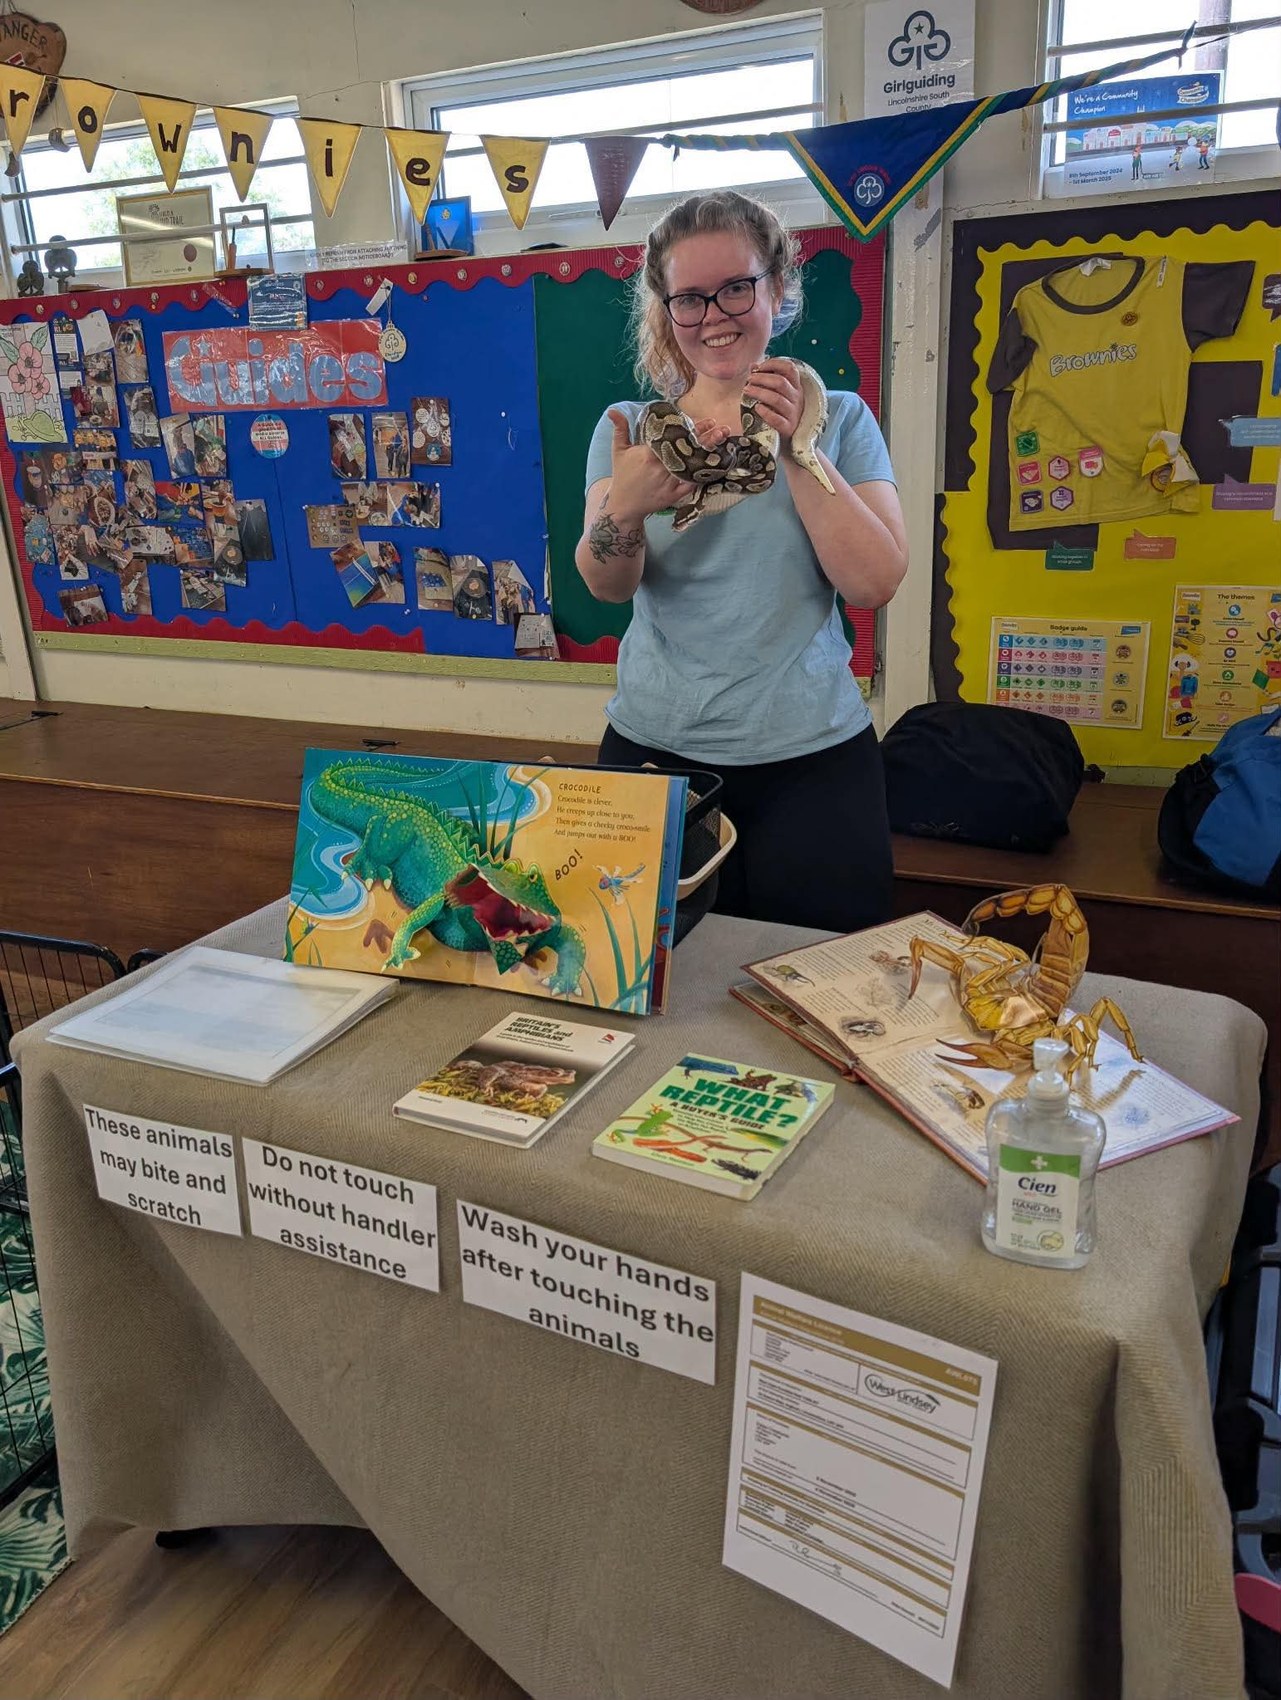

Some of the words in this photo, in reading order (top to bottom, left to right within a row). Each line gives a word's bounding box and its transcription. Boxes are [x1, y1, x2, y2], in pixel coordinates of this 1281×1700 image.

[0, 20, 48, 49] ANGER
[883, 74, 956, 94] Girlguiding
[888, 95, 928, 106] Lincolnshire
[929, 91, 950, 100] South
[1101, 89, 1139, 101] Community
[1074, 106, 1106, 115] Champion
[168, 335, 383, 407] Guides
[1049, 342, 1137, 377] Brownies
[558, 794, 586, 804] Crocodile
[559, 783, 602, 794] CROCODILE
[556, 817, 570, 825] Then
[571, 819, 586, 827] gives
[566, 808, 585, 816] creeps
[567, 830, 585, 839] jumps
[555, 849, 582, 880] BOO!
[504, 1027, 565, 1041] AMPHIBIANS
[509, 1022, 554, 1034] REPTILES
[515, 1017, 561, 1029] BRITAIN'S
[659, 1085, 798, 1127] REPTILE?
[694, 1078, 791, 1111] WHAT
[85, 1108, 141, 1140] These
[146, 1128, 233, 1158] animals
[100, 1150, 137, 1178] may
[142, 1157, 180, 1185] bite
[186, 1170, 226, 1195] and
[262, 1145, 293, 1172] Do
[299, 1159, 338, 1184] not
[343, 1167, 414, 1205] touch
[1018, 1177, 1056, 1194] Cien
[127, 1192, 202, 1227] scratch
[248, 1182, 335, 1223] without
[341, 1203, 437, 1249] handler
[1012, 1198, 1041, 1212] HAND
[280, 1227, 407, 1279] assistance
[461, 1204, 538, 1249] Wash
[545, 1237, 608, 1271] your
[616, 1255, 710, 1302] hands
[462, 1248, 524, 1281] after
[530, 1268, 658, 1331] touching
[663, 1312, 714, 1343] the
[528, 1308, 640, 1358] animals
[868, 1378, 895, 1395] West
[897, 1391, 937, 1414] Lindsey
